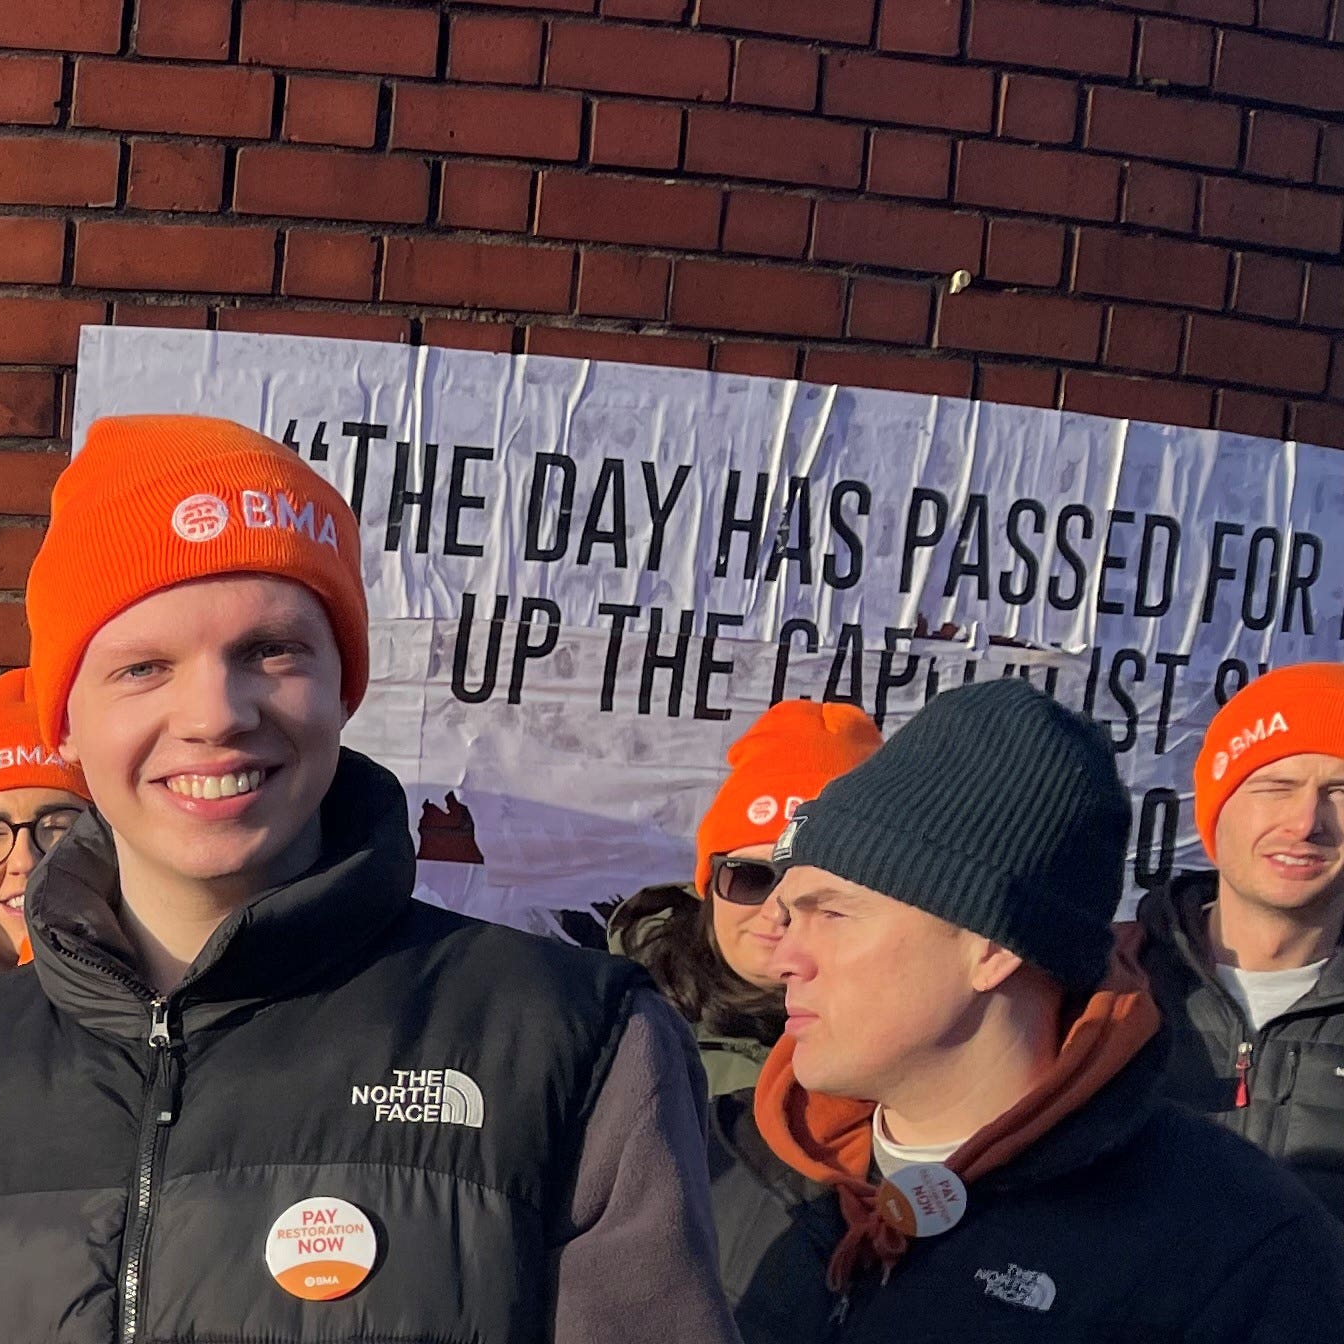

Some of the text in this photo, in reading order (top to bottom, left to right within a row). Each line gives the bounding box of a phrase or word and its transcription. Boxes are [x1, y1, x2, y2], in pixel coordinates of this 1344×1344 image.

[242, 489, 339, 555] BMA
[523, 451, 692, 572] DAY
[714, 470, 872, 590] HAS
[899, 487, 1181, 618] PASSED
[1202, 520, 1324, 636] FOR
[450, 592, 561, 705] UP
[598, 602, 745, 722] THE
[769, 618, 1190, 756] CAPIST
[1230, 711, 1289, 762] BMA
[392, 1069, 443, 1087] THE
[351, 1085, 440, 1105] NORTH
[374, 1103, 441, 1123] FACE
[301, 1208, 338, 1226] PAY
[276, 1223, 365, 1240] RESTORATION
[297, 1236, 345, 1255] NOW
[316, 1276, 340, 1286] BMA
